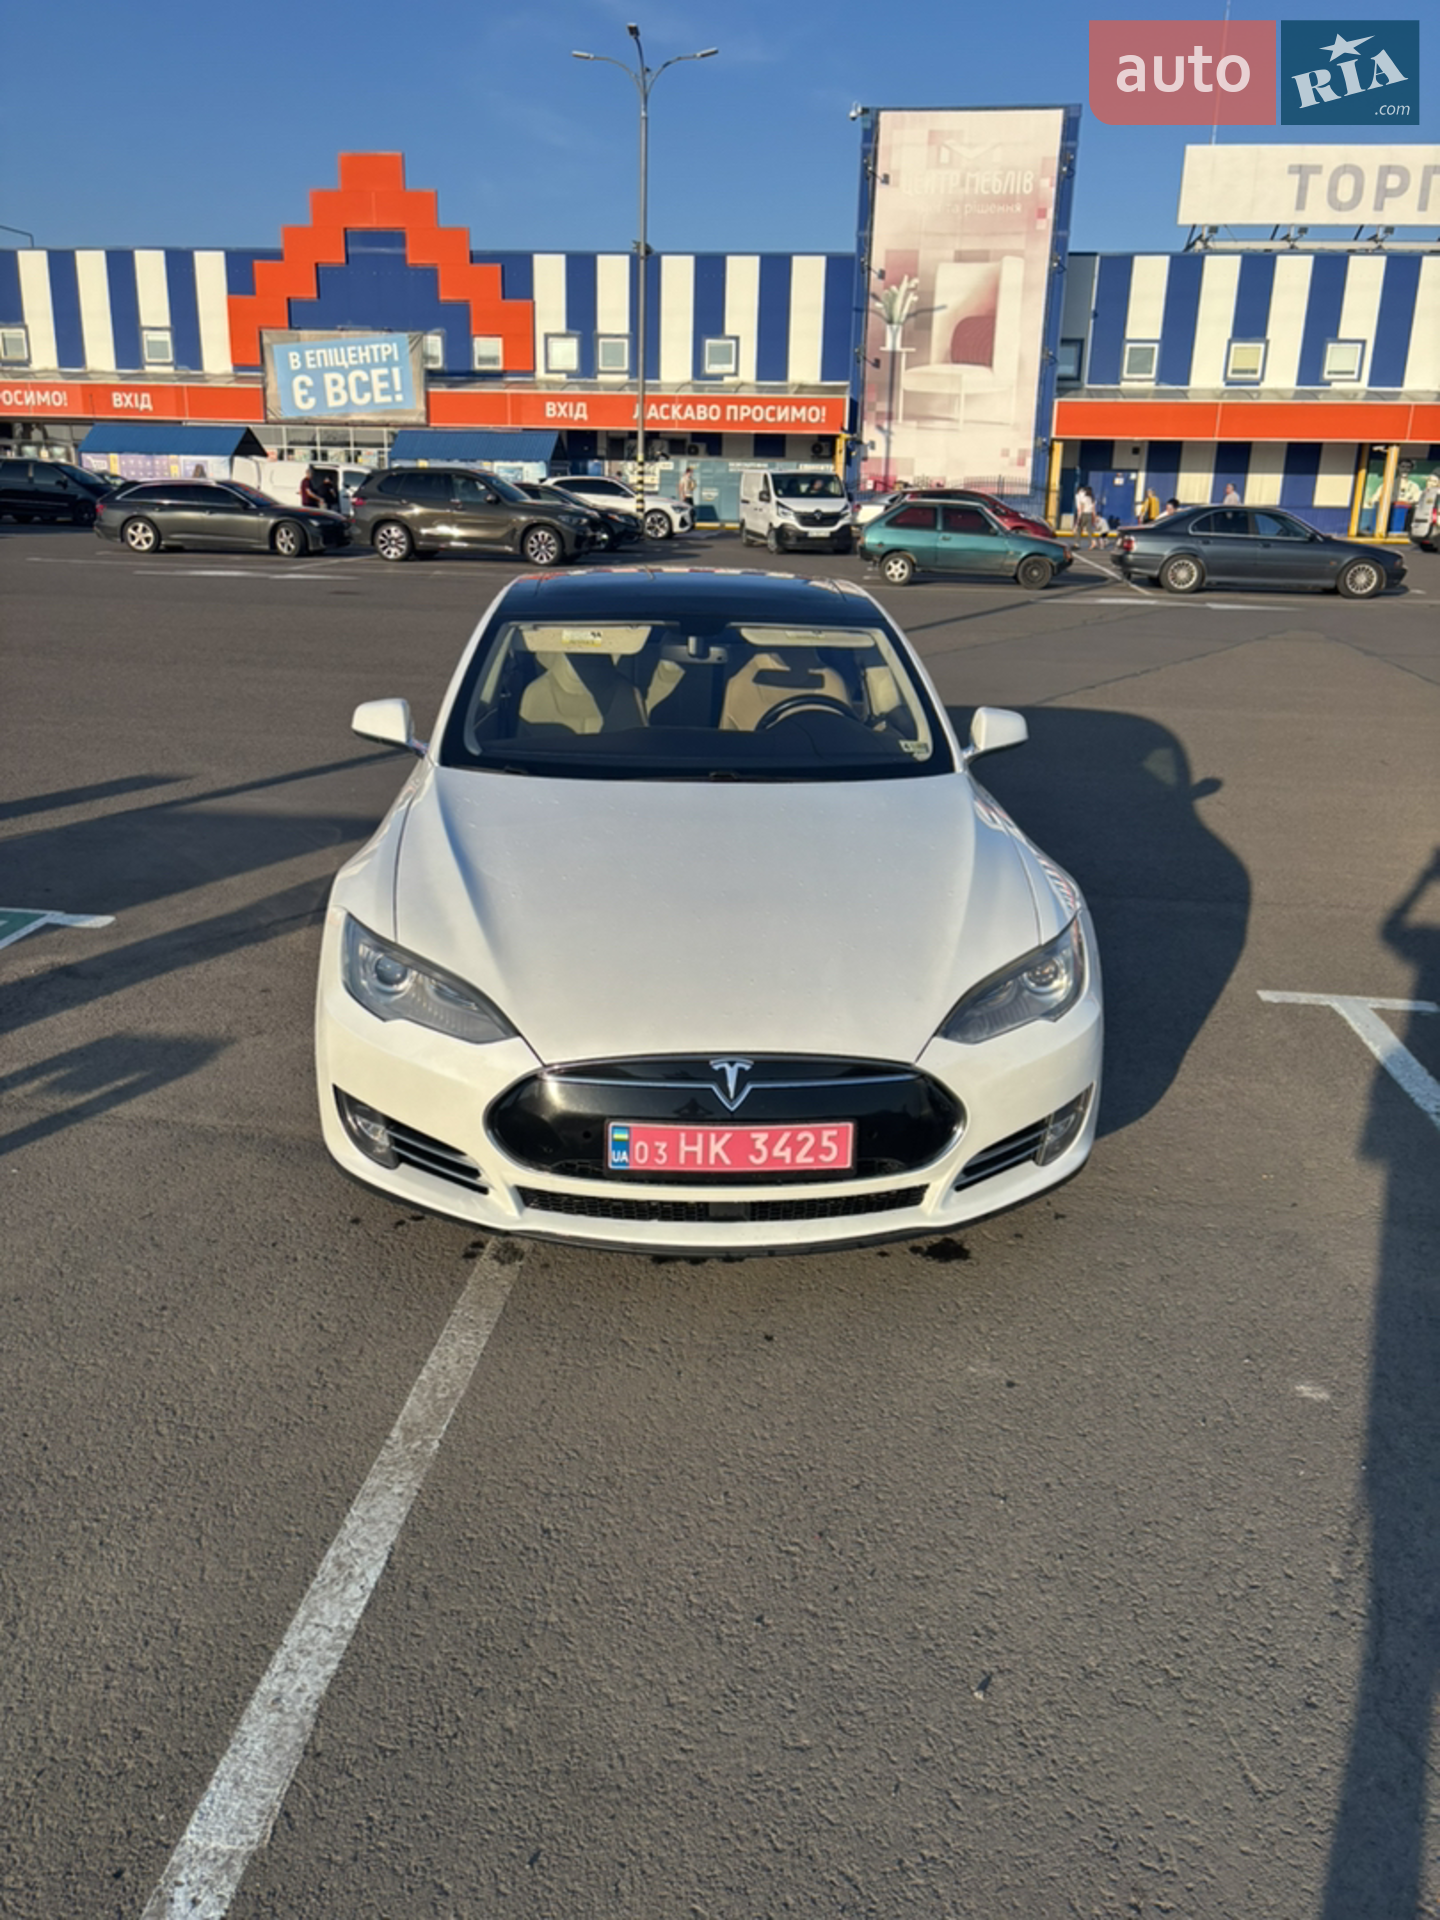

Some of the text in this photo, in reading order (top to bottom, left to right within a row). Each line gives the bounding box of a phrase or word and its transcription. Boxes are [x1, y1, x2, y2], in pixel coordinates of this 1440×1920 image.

[901, 169, 1035, 196] ЦЕНТР МЕБЛІВ
[964, 202, 1023, 216] рішення
[288, 342, 399, 371] В ЕПІЦЕНТРІ
[0, 389, 68, 407] ОСИМО!
[291, 366, 404, 411] Є ВСЕ!
[111, 391, 153, 412] ВХІД
[545, 401, 589, 421] ВХІД
[725, 405, 827, 423] ПРОСИМО!
[612, 1150, 629, 1163] UA
[748, 1130, 838, 1165] 3425
